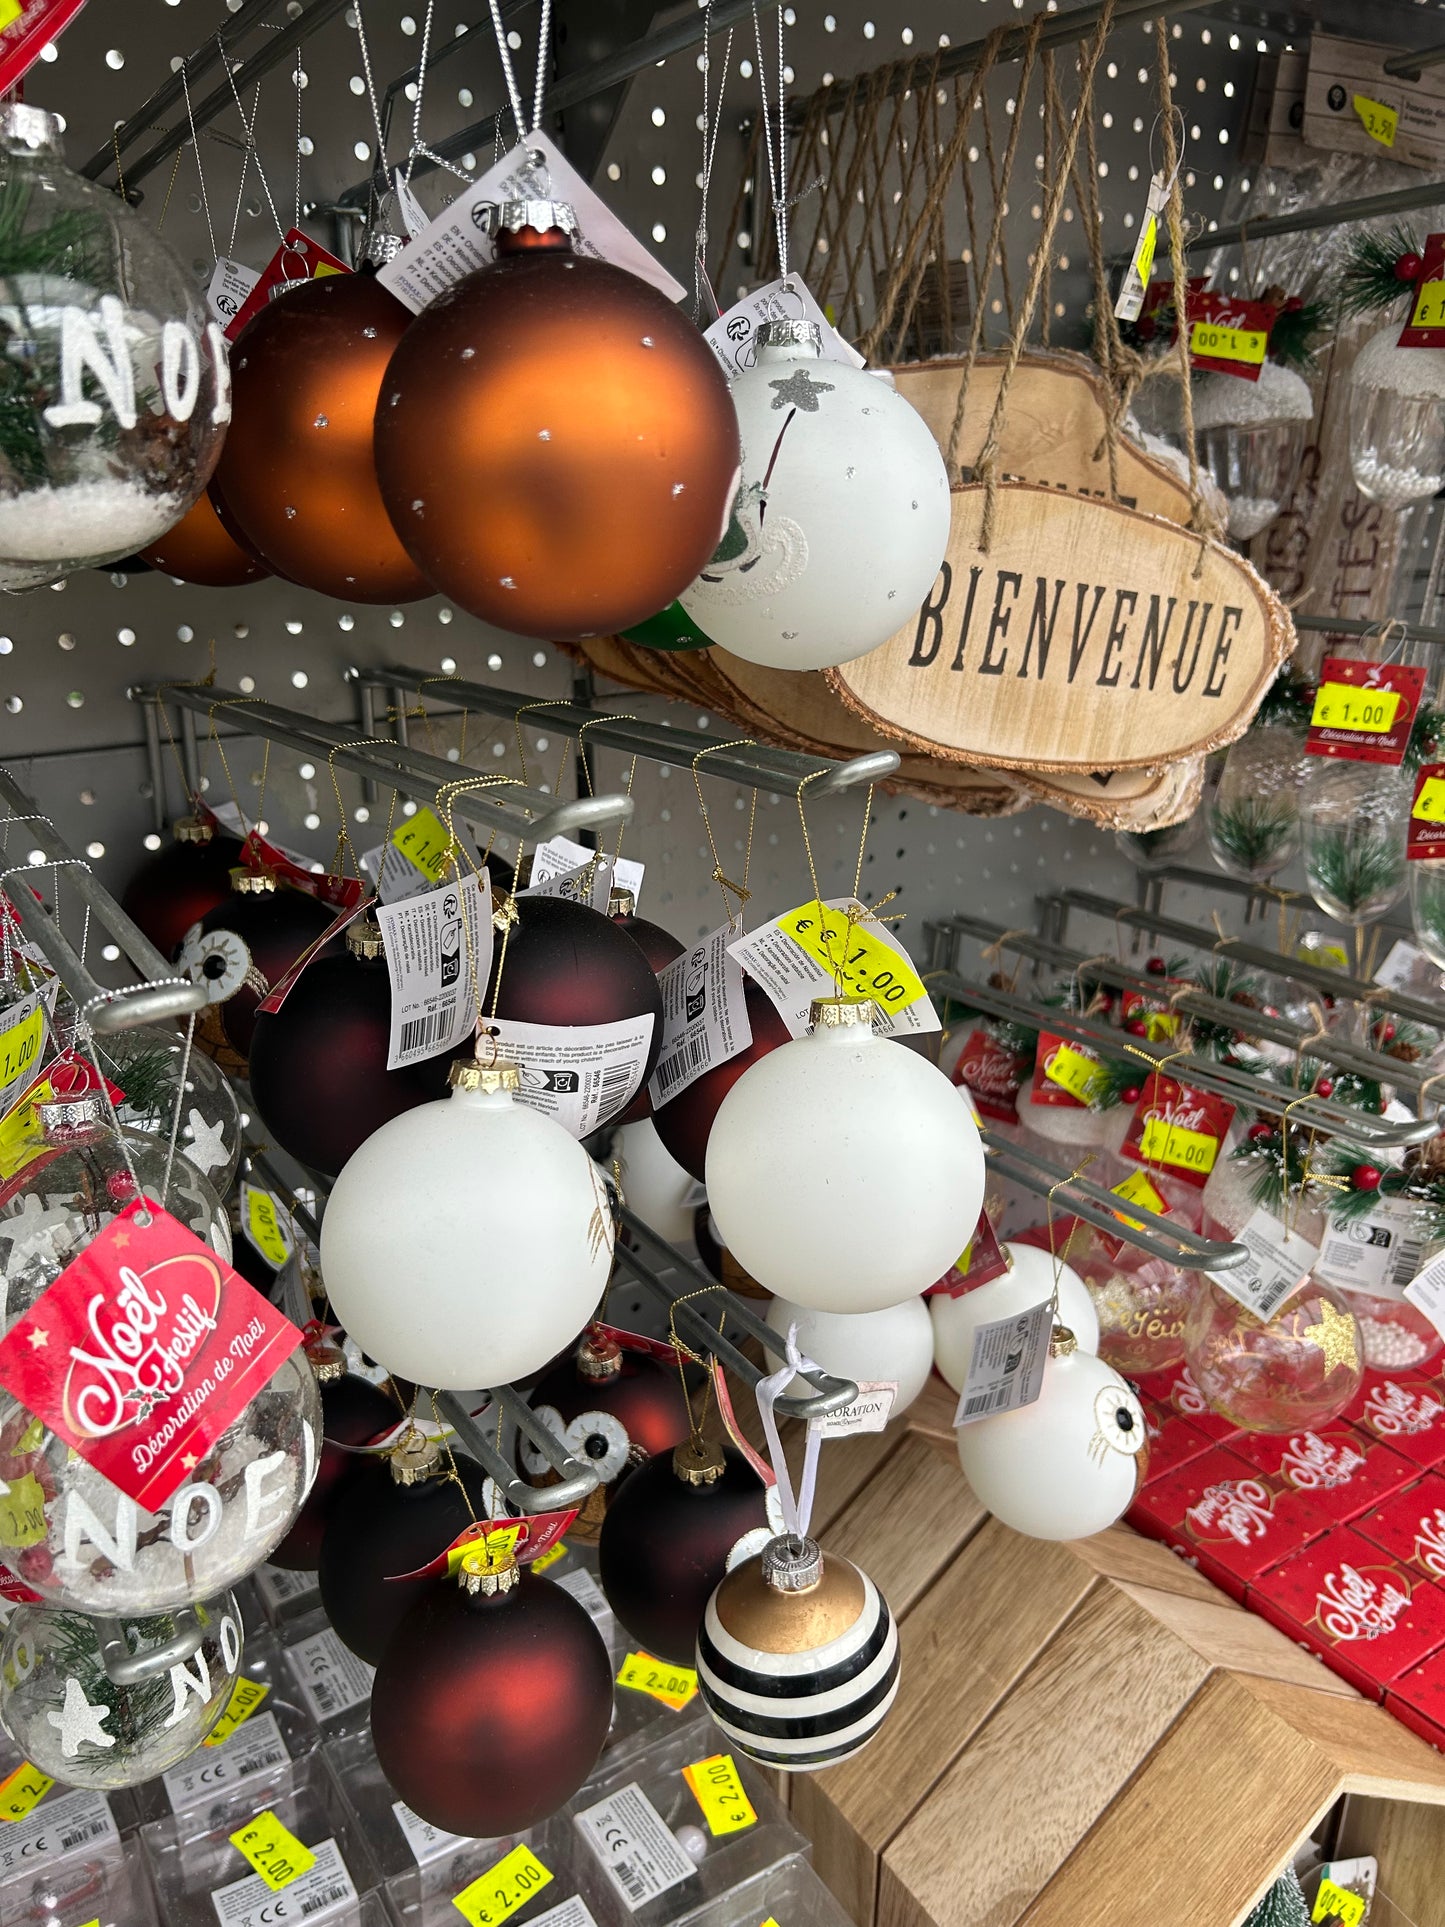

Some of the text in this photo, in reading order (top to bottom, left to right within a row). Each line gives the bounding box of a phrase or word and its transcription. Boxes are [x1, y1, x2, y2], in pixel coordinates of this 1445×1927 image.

[908, 560, 1244, 698] BIENVENUE
[1320, 703, 1385, 725] € 1.00
[402, 833, 416, 846] €
[795, 919, 814, 933] €
[819, 929, 906, 1002] € 1.00
[402, 1004, 412, 1013] LOT
[796, 1009, 809, 1019] LOT
[4, 1033, 34, 1078] 1.00
[604, 1044, 631, 1054] decorative
[686, 1060, 708, 1080] 665466
[1169, 1138, 1205, 1164] 1.00
[70, 1266, 168, 1434] Noël
[131, 1317, 267, 1474] Décoration de Noël
[626, 1669, 689, 1695] € 2.00
[211, 1685, 261, 1741] € 2.00
[706, 1762, 747, 1824] € 2.00
[10, 1802, 26, 1814] €
[241, 1829, 295, 1882] € 2.00
[478, 1908, 494, 1924] €
[494, 1864, 542, 1909] 2.00
